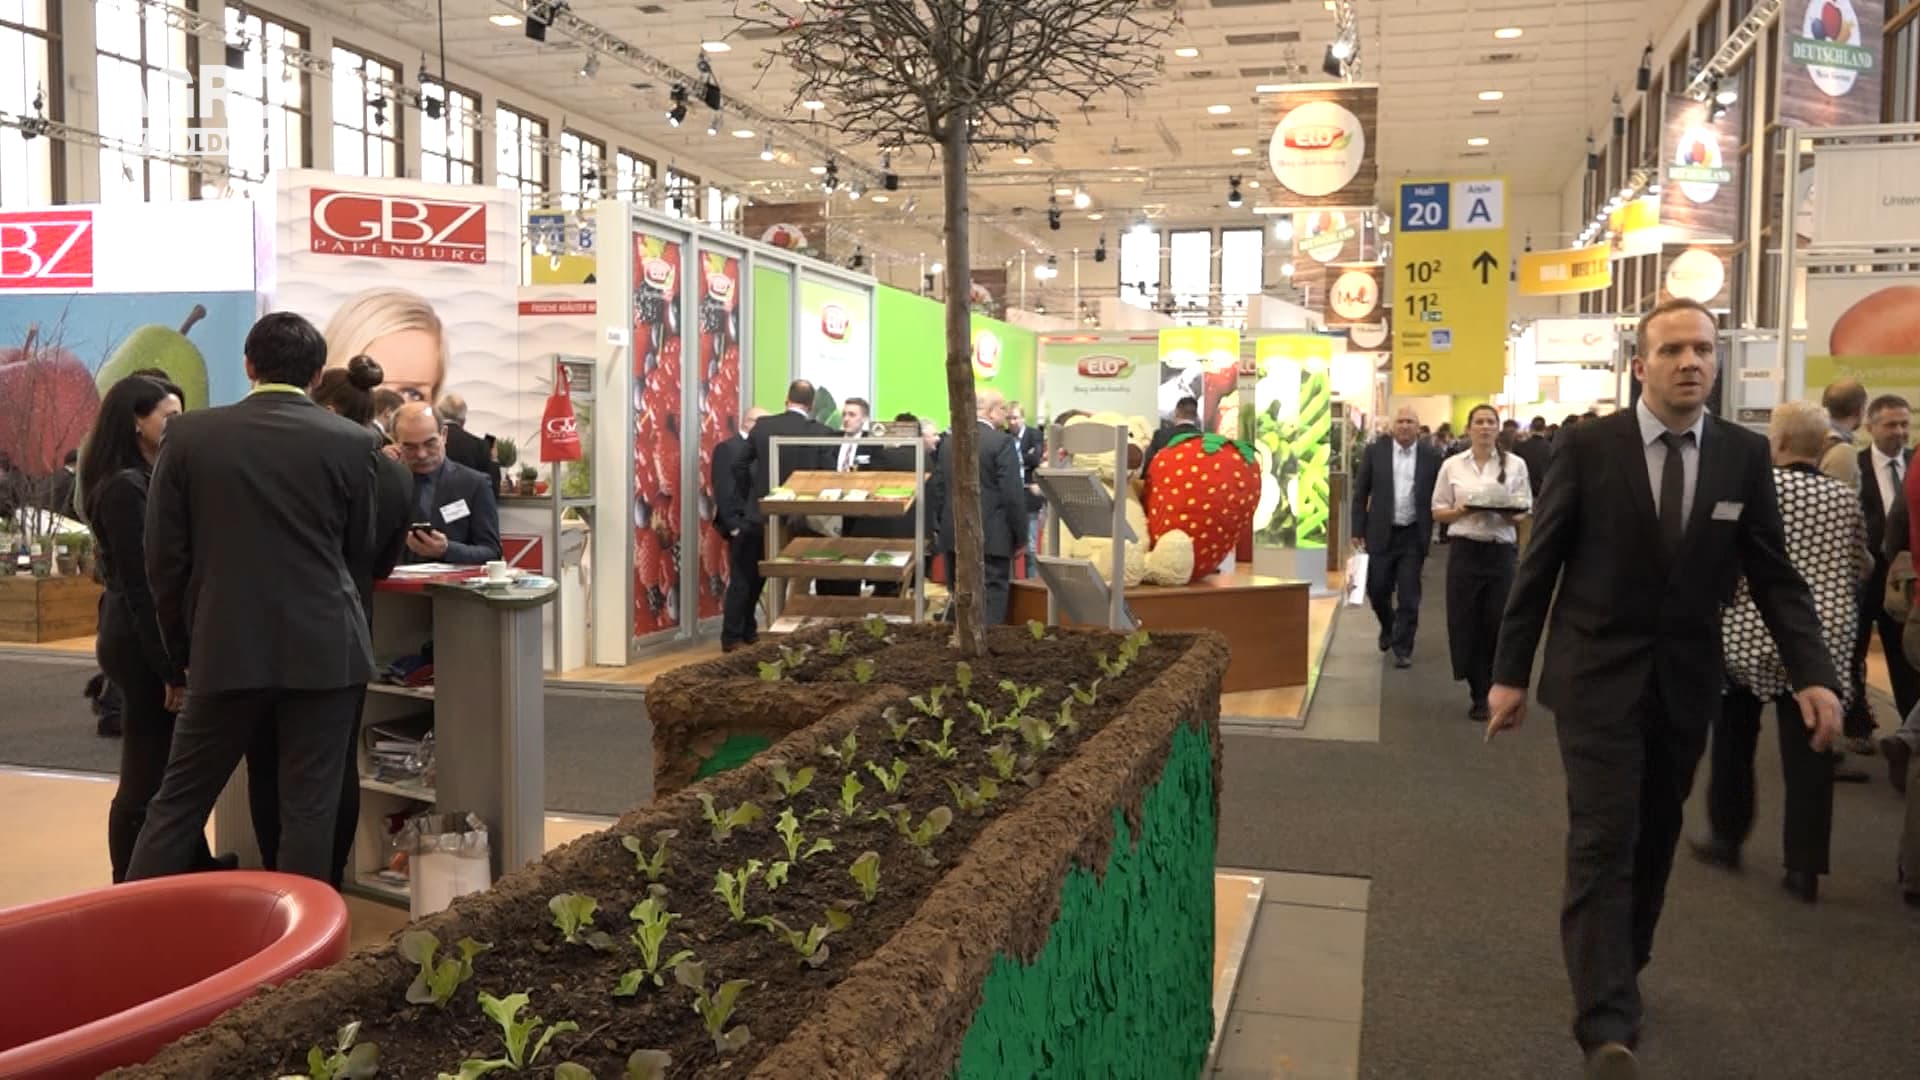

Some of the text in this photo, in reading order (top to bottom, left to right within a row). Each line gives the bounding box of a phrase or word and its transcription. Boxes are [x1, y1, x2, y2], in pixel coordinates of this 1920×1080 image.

[1792, 40, 1873, 69] DEUTSCHLAND
[1414, 186, 1435, 197] Hall
[313, 192, 485, 249] GBZ
[1408, 202, 1442, 226] 20
[1467, 198, 1492, 223] A
[314, 239, 485, 262] PAPENBURG
[1404, 361, 1430, 383] 18
